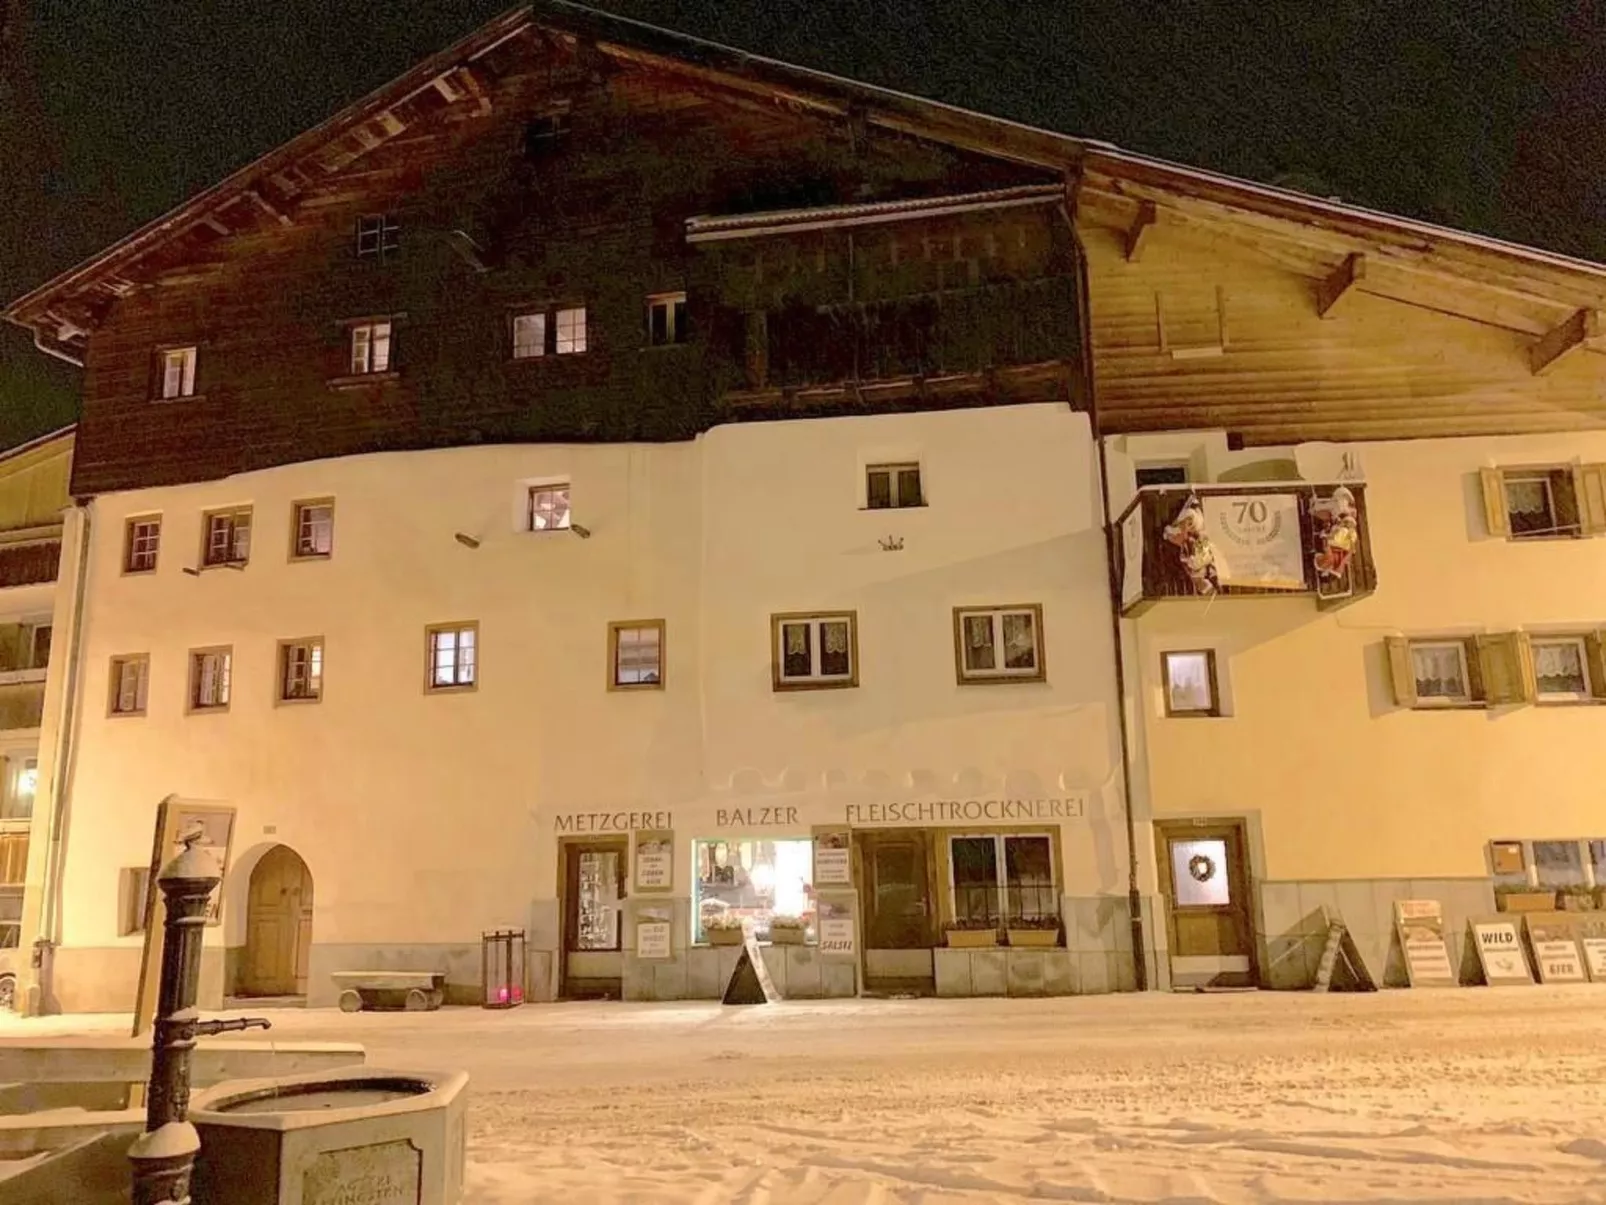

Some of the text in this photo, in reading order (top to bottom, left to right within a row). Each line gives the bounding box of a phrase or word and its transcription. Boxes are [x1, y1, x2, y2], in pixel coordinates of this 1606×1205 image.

[1232, 502, 1267, 524] 70
[554, 799, 1083, 831] METZGEREI BALZER FLEISCHTROCKNEREI
[1481, 932, 1513, 944] WILD
